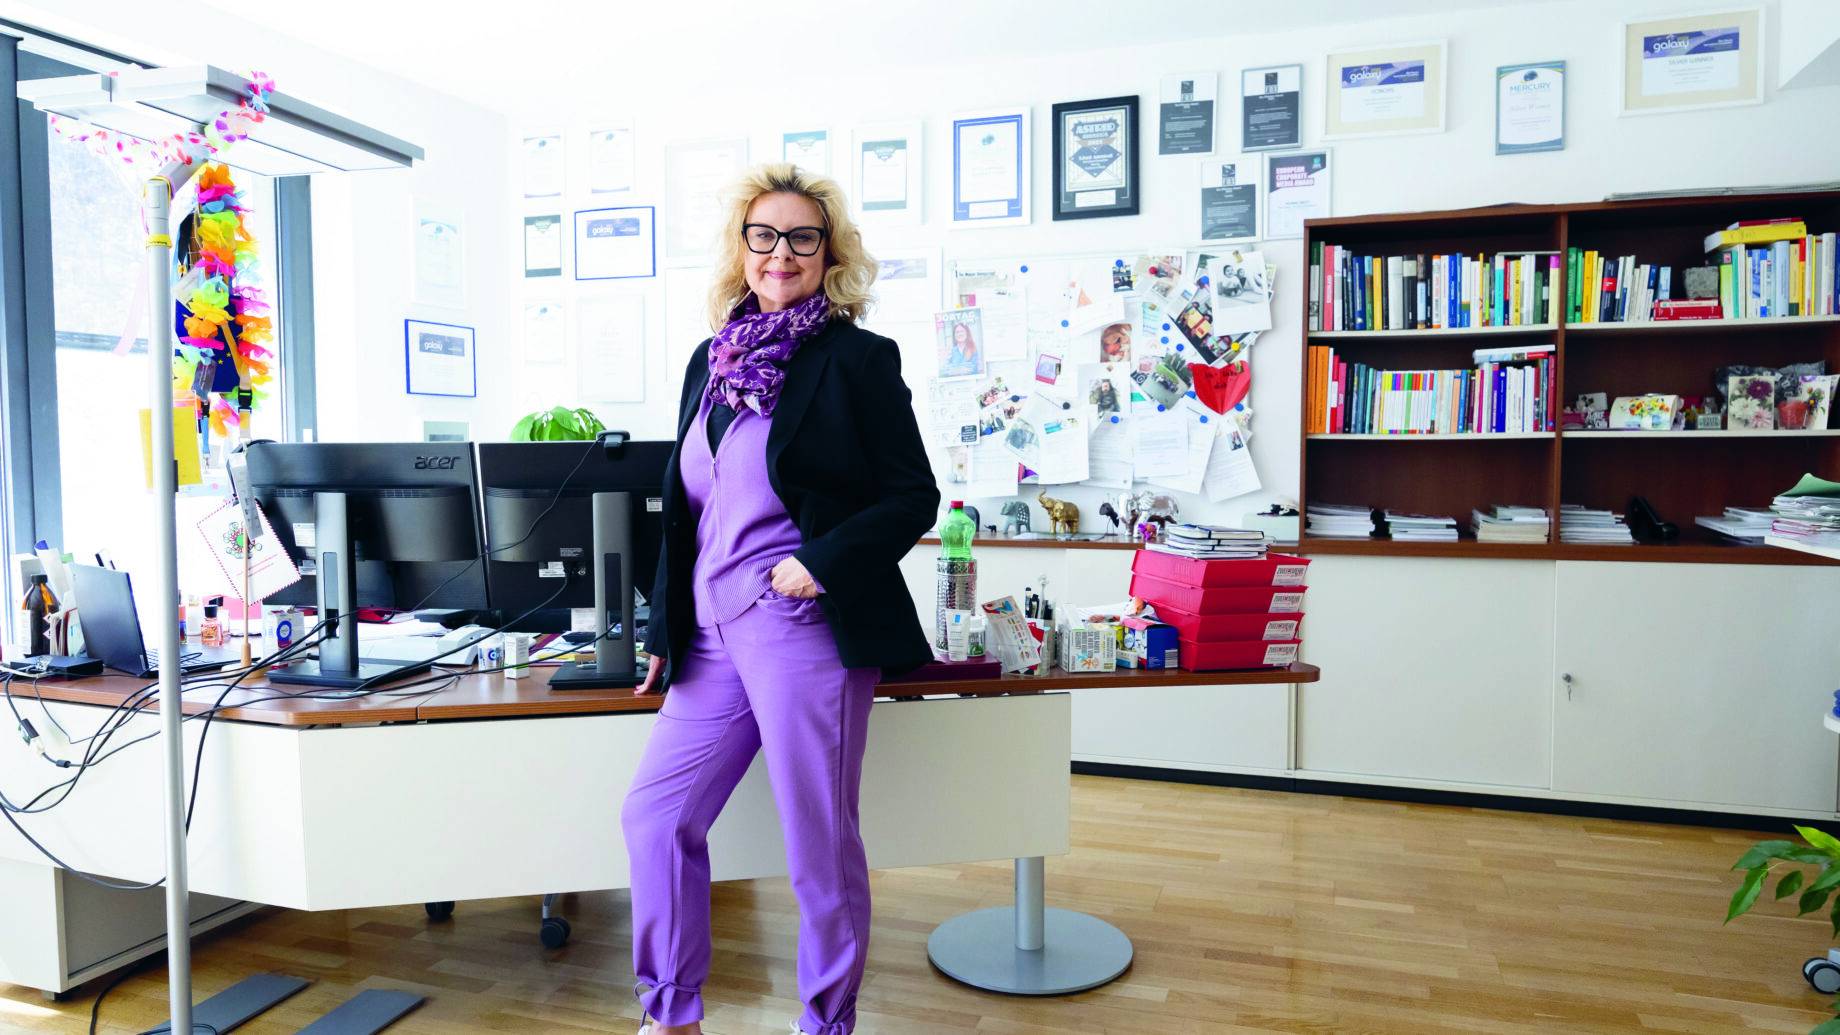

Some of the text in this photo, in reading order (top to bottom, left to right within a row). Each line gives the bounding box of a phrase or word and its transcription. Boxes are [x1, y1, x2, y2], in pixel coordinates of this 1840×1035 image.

[1653, 39, 1690, 53] galaxy
[1350, 69, 1382, 84] galaxy
[414, 456, 461, 470] acer
